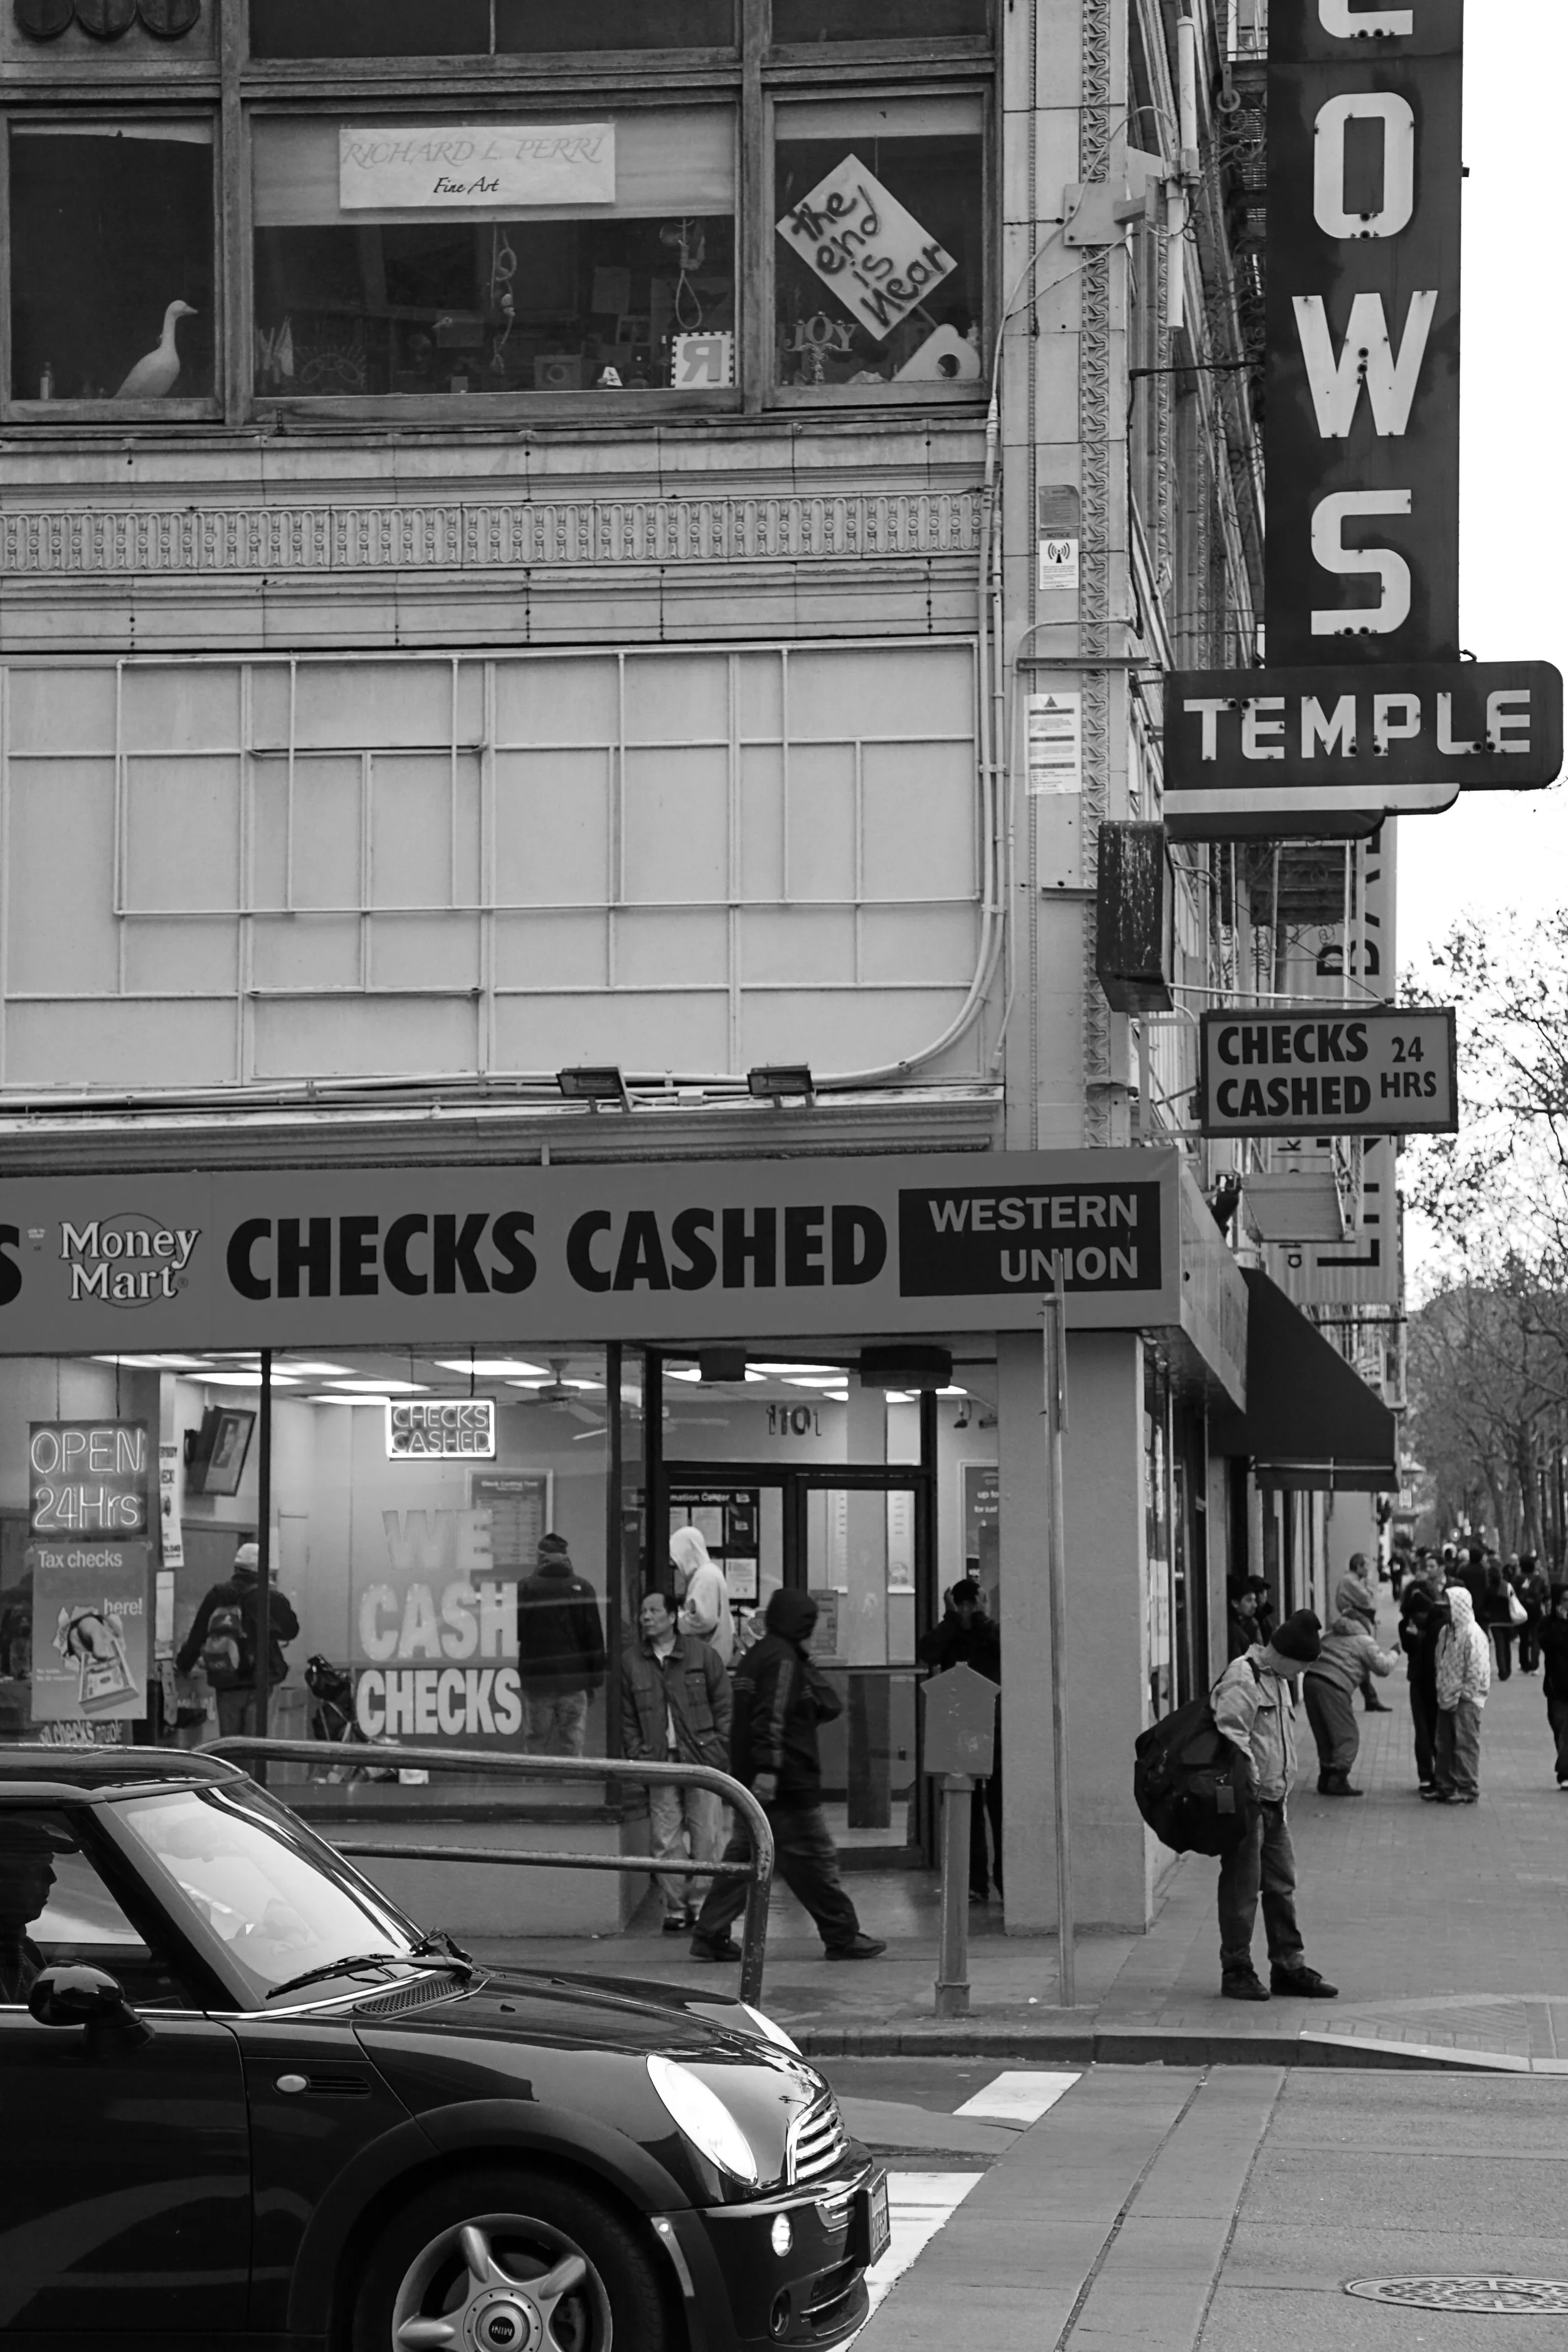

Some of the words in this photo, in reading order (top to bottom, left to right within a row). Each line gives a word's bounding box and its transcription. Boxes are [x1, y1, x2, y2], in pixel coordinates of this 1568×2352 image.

[342, 139, 475, 169] RICHARD
[515, 137, 603, 164] PERRI
[433, 176, 465, 193] Fine
[467, 176, 500, 194] Art
[788, 192, 857, 241] the
[817, 184, 879, 275] end
[850, 254, 894, 289] is
[785, 315, 859, 352] JOY
[1292, 0, 1438, 635] OWS
[1184, 689, 1530, 761] TEMPLE
[1217, 1022, 1368, 1065] CHECKS
[1392, 1036, 1424, 1062] 24
[1217, 1076, 1371, 1117] CASHED
[1381, 1071, 1436, 1098] HRS
[928, 1195, 1137, 1232] WESTERN
[59, 1220, 201, 1269] Money
[227, 1211, 537, 1300] CHECKS
[566, 1205, 887, 1293] CASHED
[70, 1261, 178, 1300] Mart
[1000, 1247, 1138, 1282] UNION
[393, 1406, 488, 1428] CHECKS
[766, 1405, 822, 1436] 1101
[31, 1428, 146, 1474] OPEN
[392, 1430, 490, 1453] CASHED
[381, 1509, 494, 1569] WE
[38, 1550, 65, 1568] Tax
[67, 1549, 122, 1568] checks
[103, 1598, 142, 1616] here!
[358, 1581, 521, 1661] CASH
[356, 1667, 522, 1737] CHECKS
[491, 2325, 513, 2337] MINI
